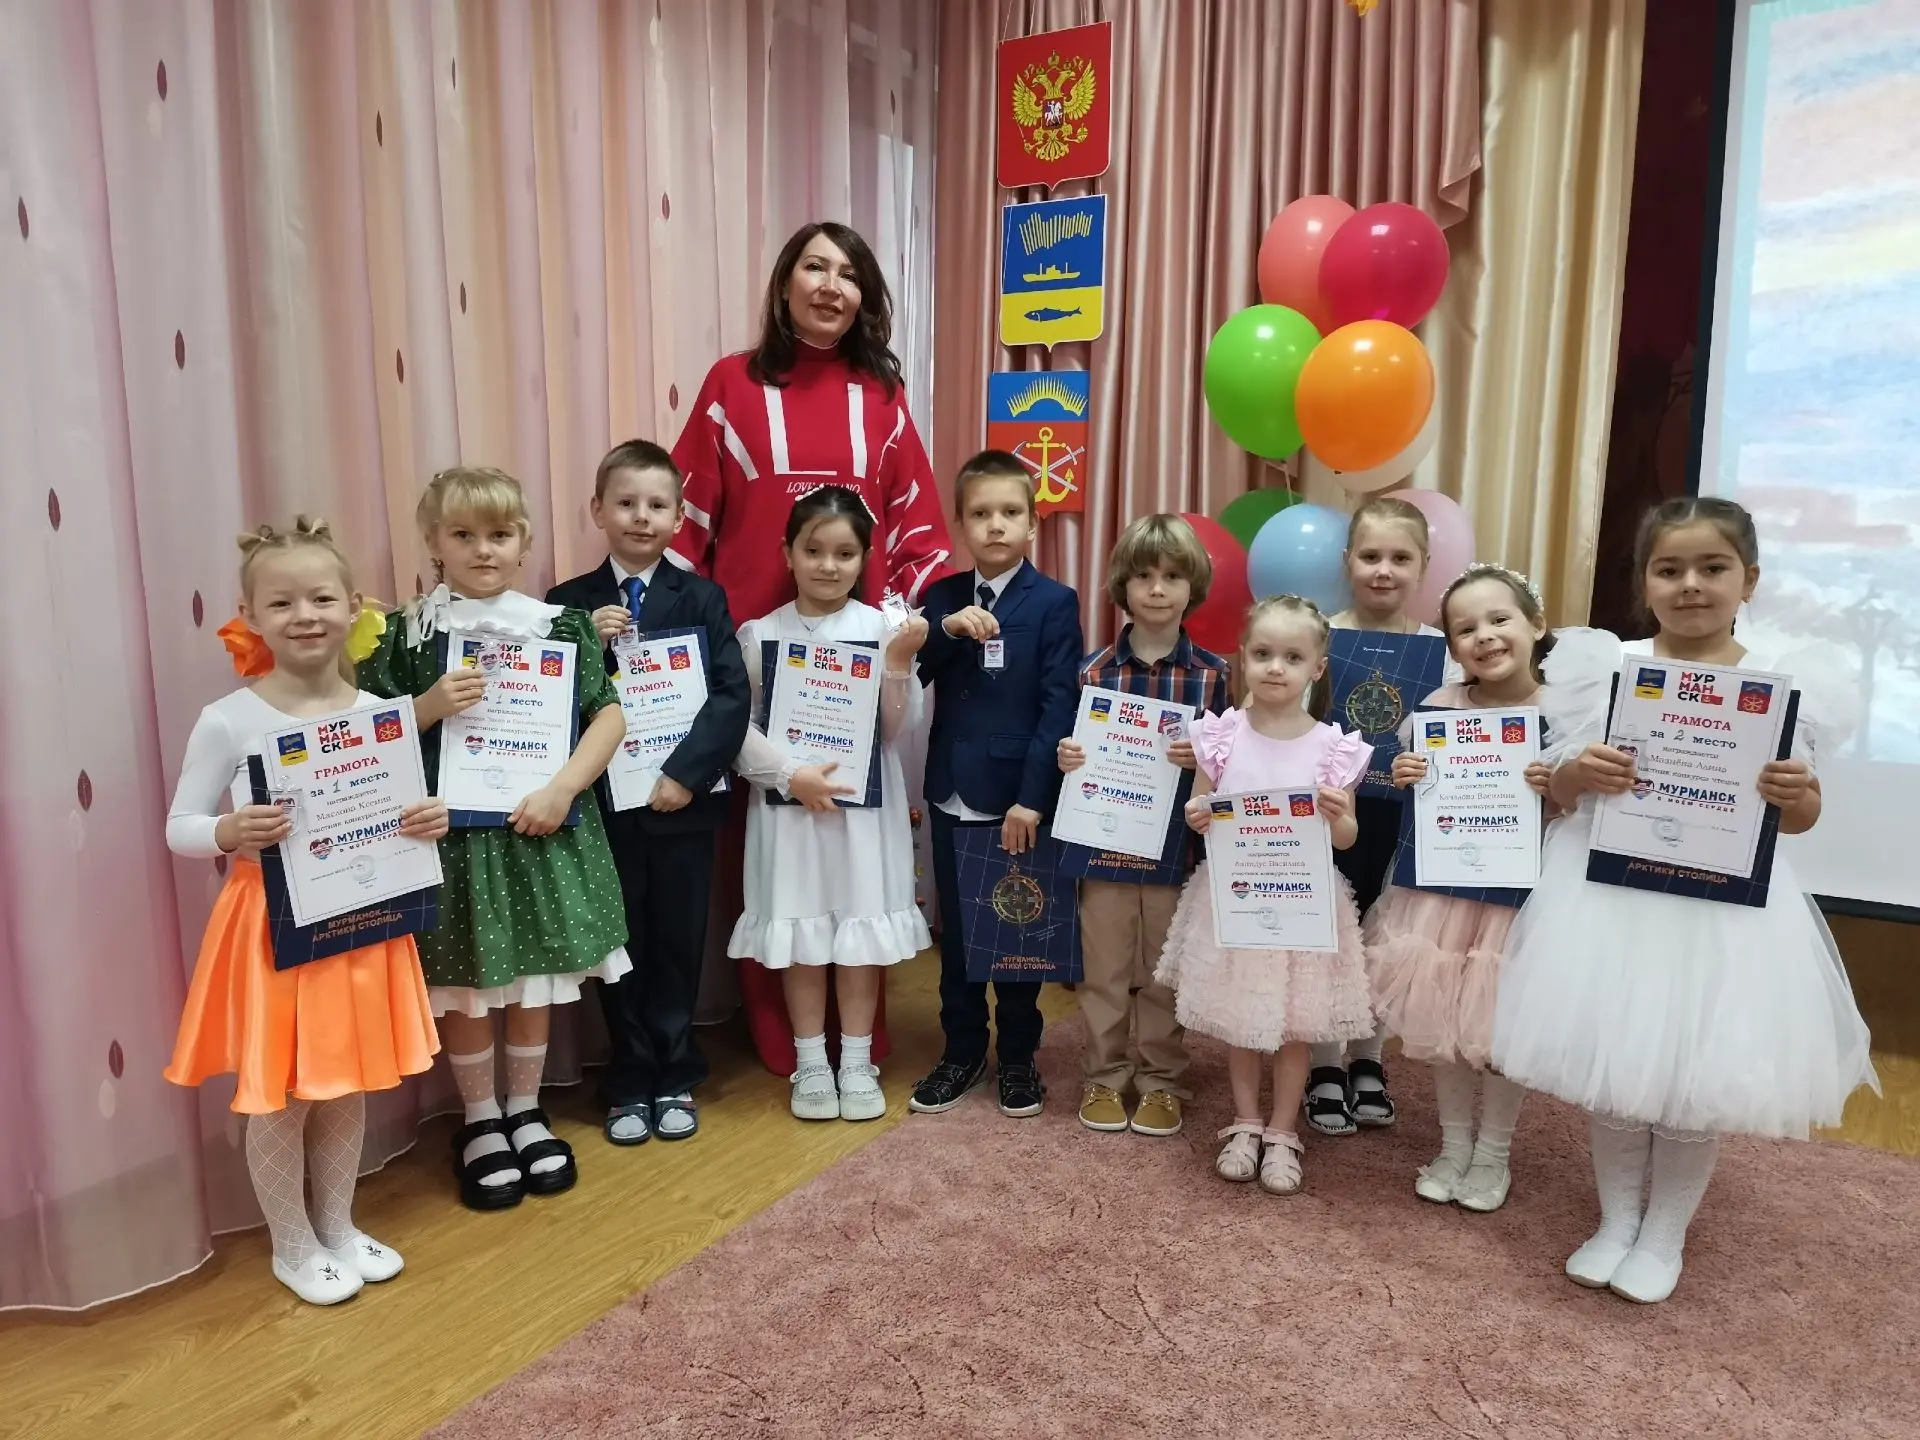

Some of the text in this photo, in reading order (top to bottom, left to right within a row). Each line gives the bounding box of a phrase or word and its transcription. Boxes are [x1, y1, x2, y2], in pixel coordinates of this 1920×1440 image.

[816, 647, 837, 655] МУР
[814, 654, 836, 663] МАН
[814, 662, 828, 670] СК
[1680, 672, 1716, 683] МУР
[488, 681, 538, 692] АМОТА
[626, 680, 674, 694] ГРАМОТА
[806, 678, 848, 692] ГРАМОТА
[1679, 682, 1714, 694] МАН
[652, 694, 682, 704] место
[824, 696, 852, 705] место
[1678, 692, 1700, 702] СК
[1121, 702, 1144, 710] МУР
[1120, 709, 1144, 720] МАН
[1118, 716, 1132, 726] СК
[1456, 718, 1482, 727] МУР
[1661, 712, 1732, 731] ГРАМОТА
[318, 720, 350, 735] МУР
[1456, 726, 1482, 736] МАН
[320, 730, 351, 744] МАН
[644, 731, 688, 745] МУРМАНС
[804, 732, 854, 746] МУРМАНСК
[1106, 732, 1153, 748] ГРАМОТА
[1458, 736, 1474, 744] СК
[1650, 730, 1736, 748] за 2 место
[322, 742, 342, 754] СК
[489, 739, 548, 750] МУРМАНСК
[1126, 751, 1156, 761] место
[1450, 754, 1502, 764] ГРАМОТА
[314, 756, 380, 780] ГРАМОТА
[1462, 768, 1468, 778] 2
[1476, 770, 1510, 778] место
[310, 772, 389, 797] за 1 место
[1102, 786, 1154, 802] МУРМАНСК
[1660, 782, 1736, 803] МУРМАНСК
[1244, 802, 1270, 810] МАН
[1459, 816, 1518, 825] МУРМАНСК
[1239, 826, 1292, 834] ГРАМОТА
[1122, 860, 1156, 870] СТОЛИЦА
[1628, 862, 1728, 884] АРКТИКИ СТОЛИЦА
[1254, 882, 1312, 891] МУРМАНСК
[328, 908, 382, 928] МУРМАНСК
[312, 913, 402, 942] АРКТИКИ СТОЛИЦА
